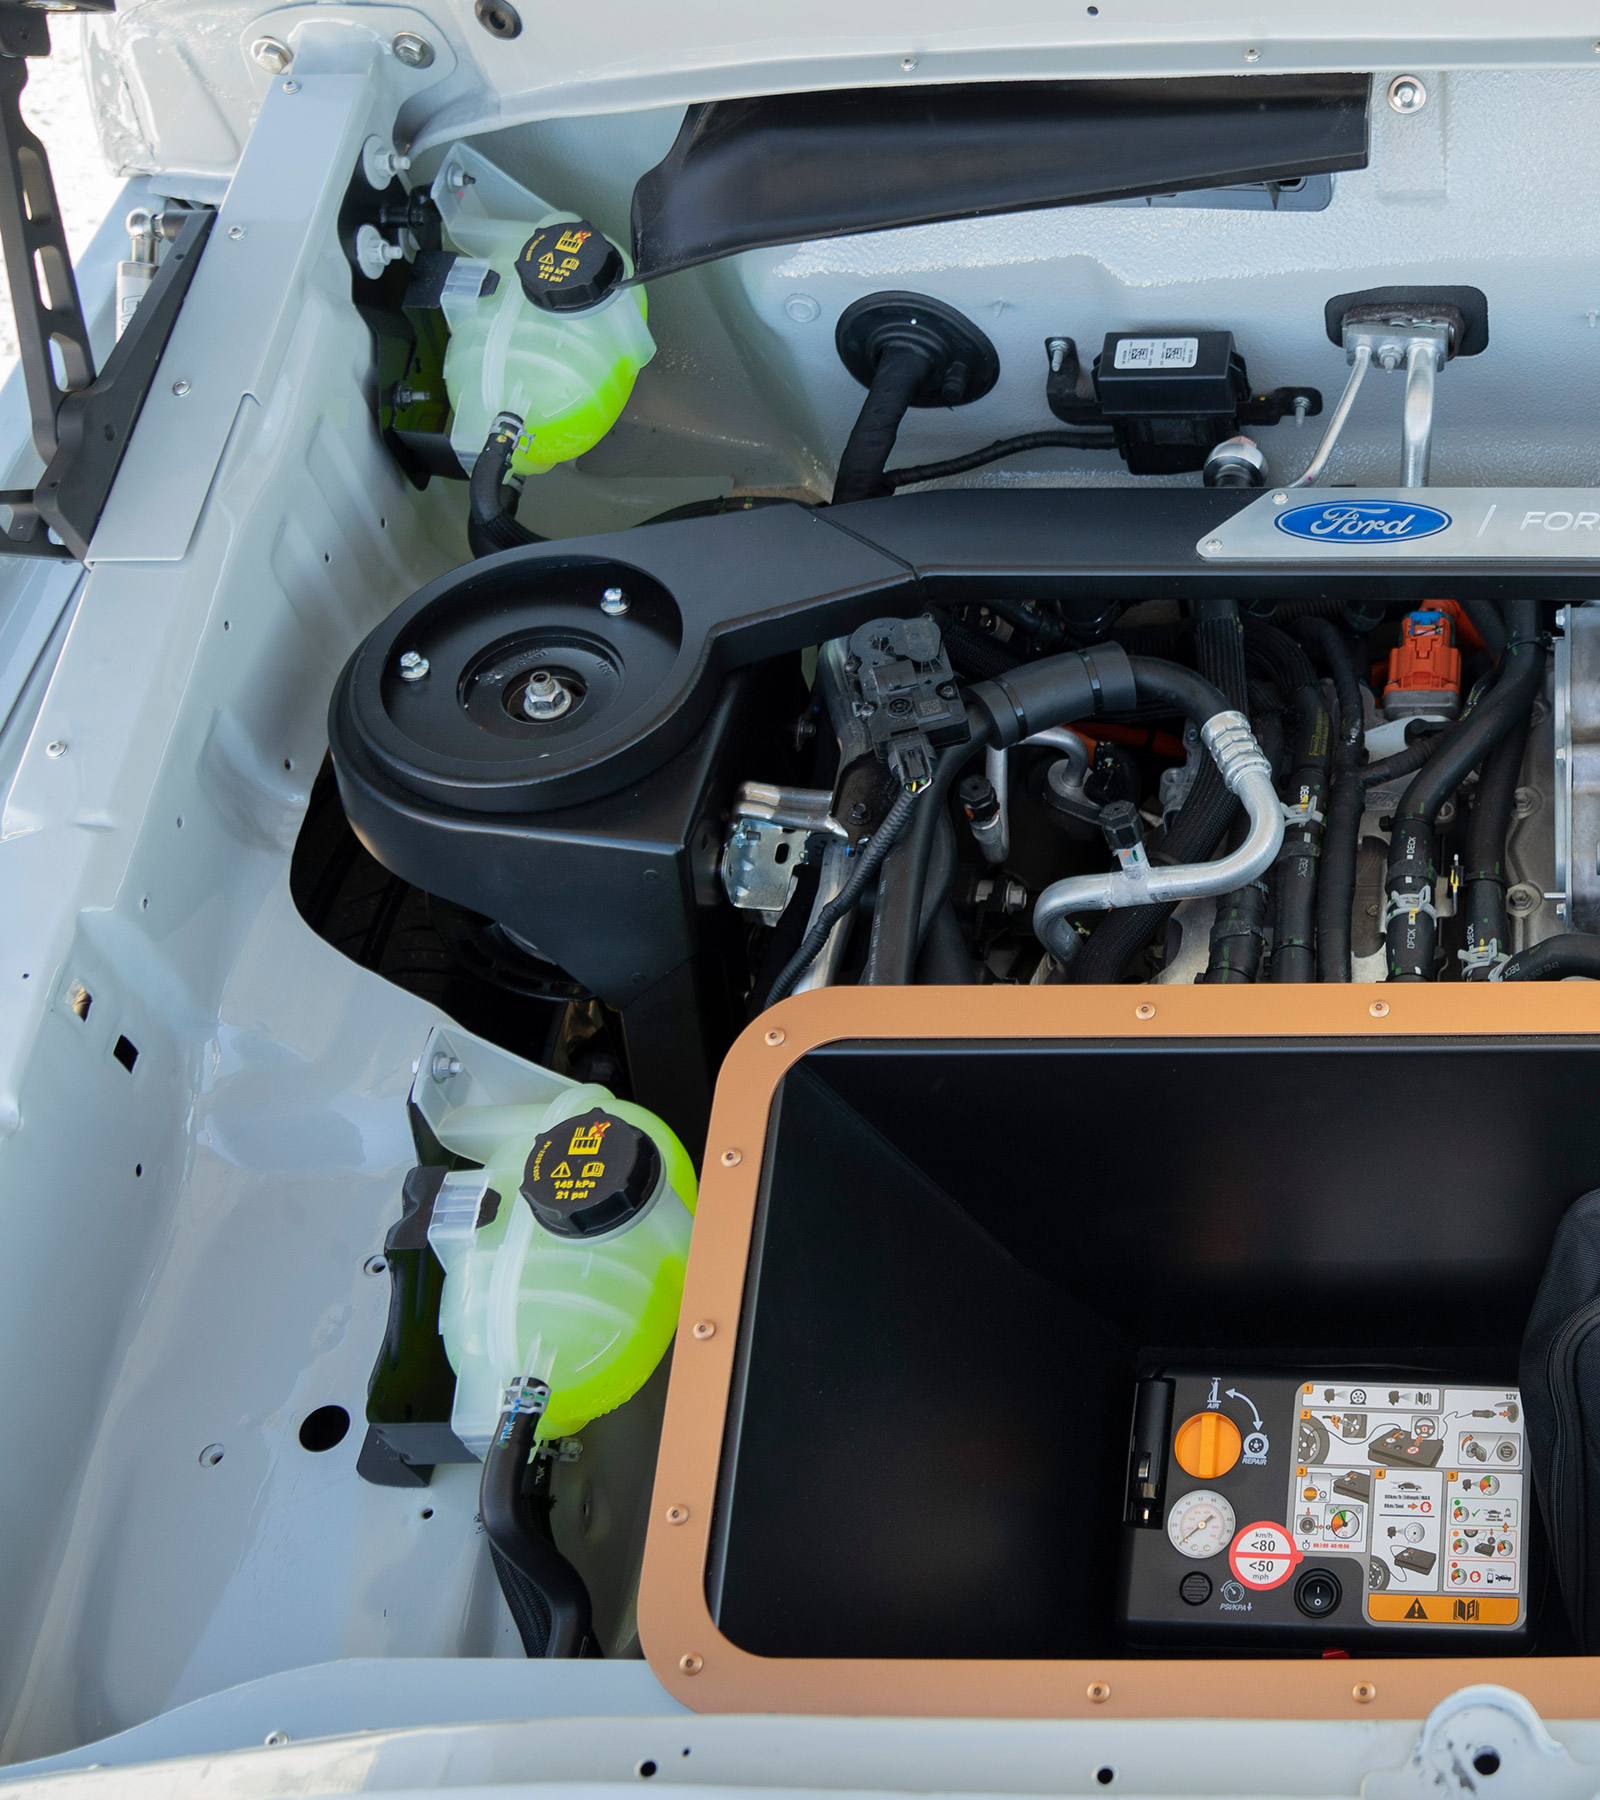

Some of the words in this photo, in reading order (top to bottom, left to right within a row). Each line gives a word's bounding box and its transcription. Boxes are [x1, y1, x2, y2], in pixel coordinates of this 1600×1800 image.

[539, 264, 554, 273] 145
[554, 266, 570, 277] kPa
[550, 274, 564, 283] psi
[1310, 507, 1416, 535] Ford
[1406, 836, 1416, 854] DECK
[1298, 858, 1308, 877] DECK
[1467, 923, 1475, 945] DECK
[554, 1181, 574, 1189] 145
[575, 1179, 597, 1189] kPa
[555, 1191, 571, 1200] 21
[571, 1190, 589, 1201] psi
[1206, 1402, 1220, 1410] AIR
[1241, 1458, 1267, 1466] REPAIR
[1251, 1540, 1275, 1552] <80
[1249, 1560, 1274, 1572] <50
